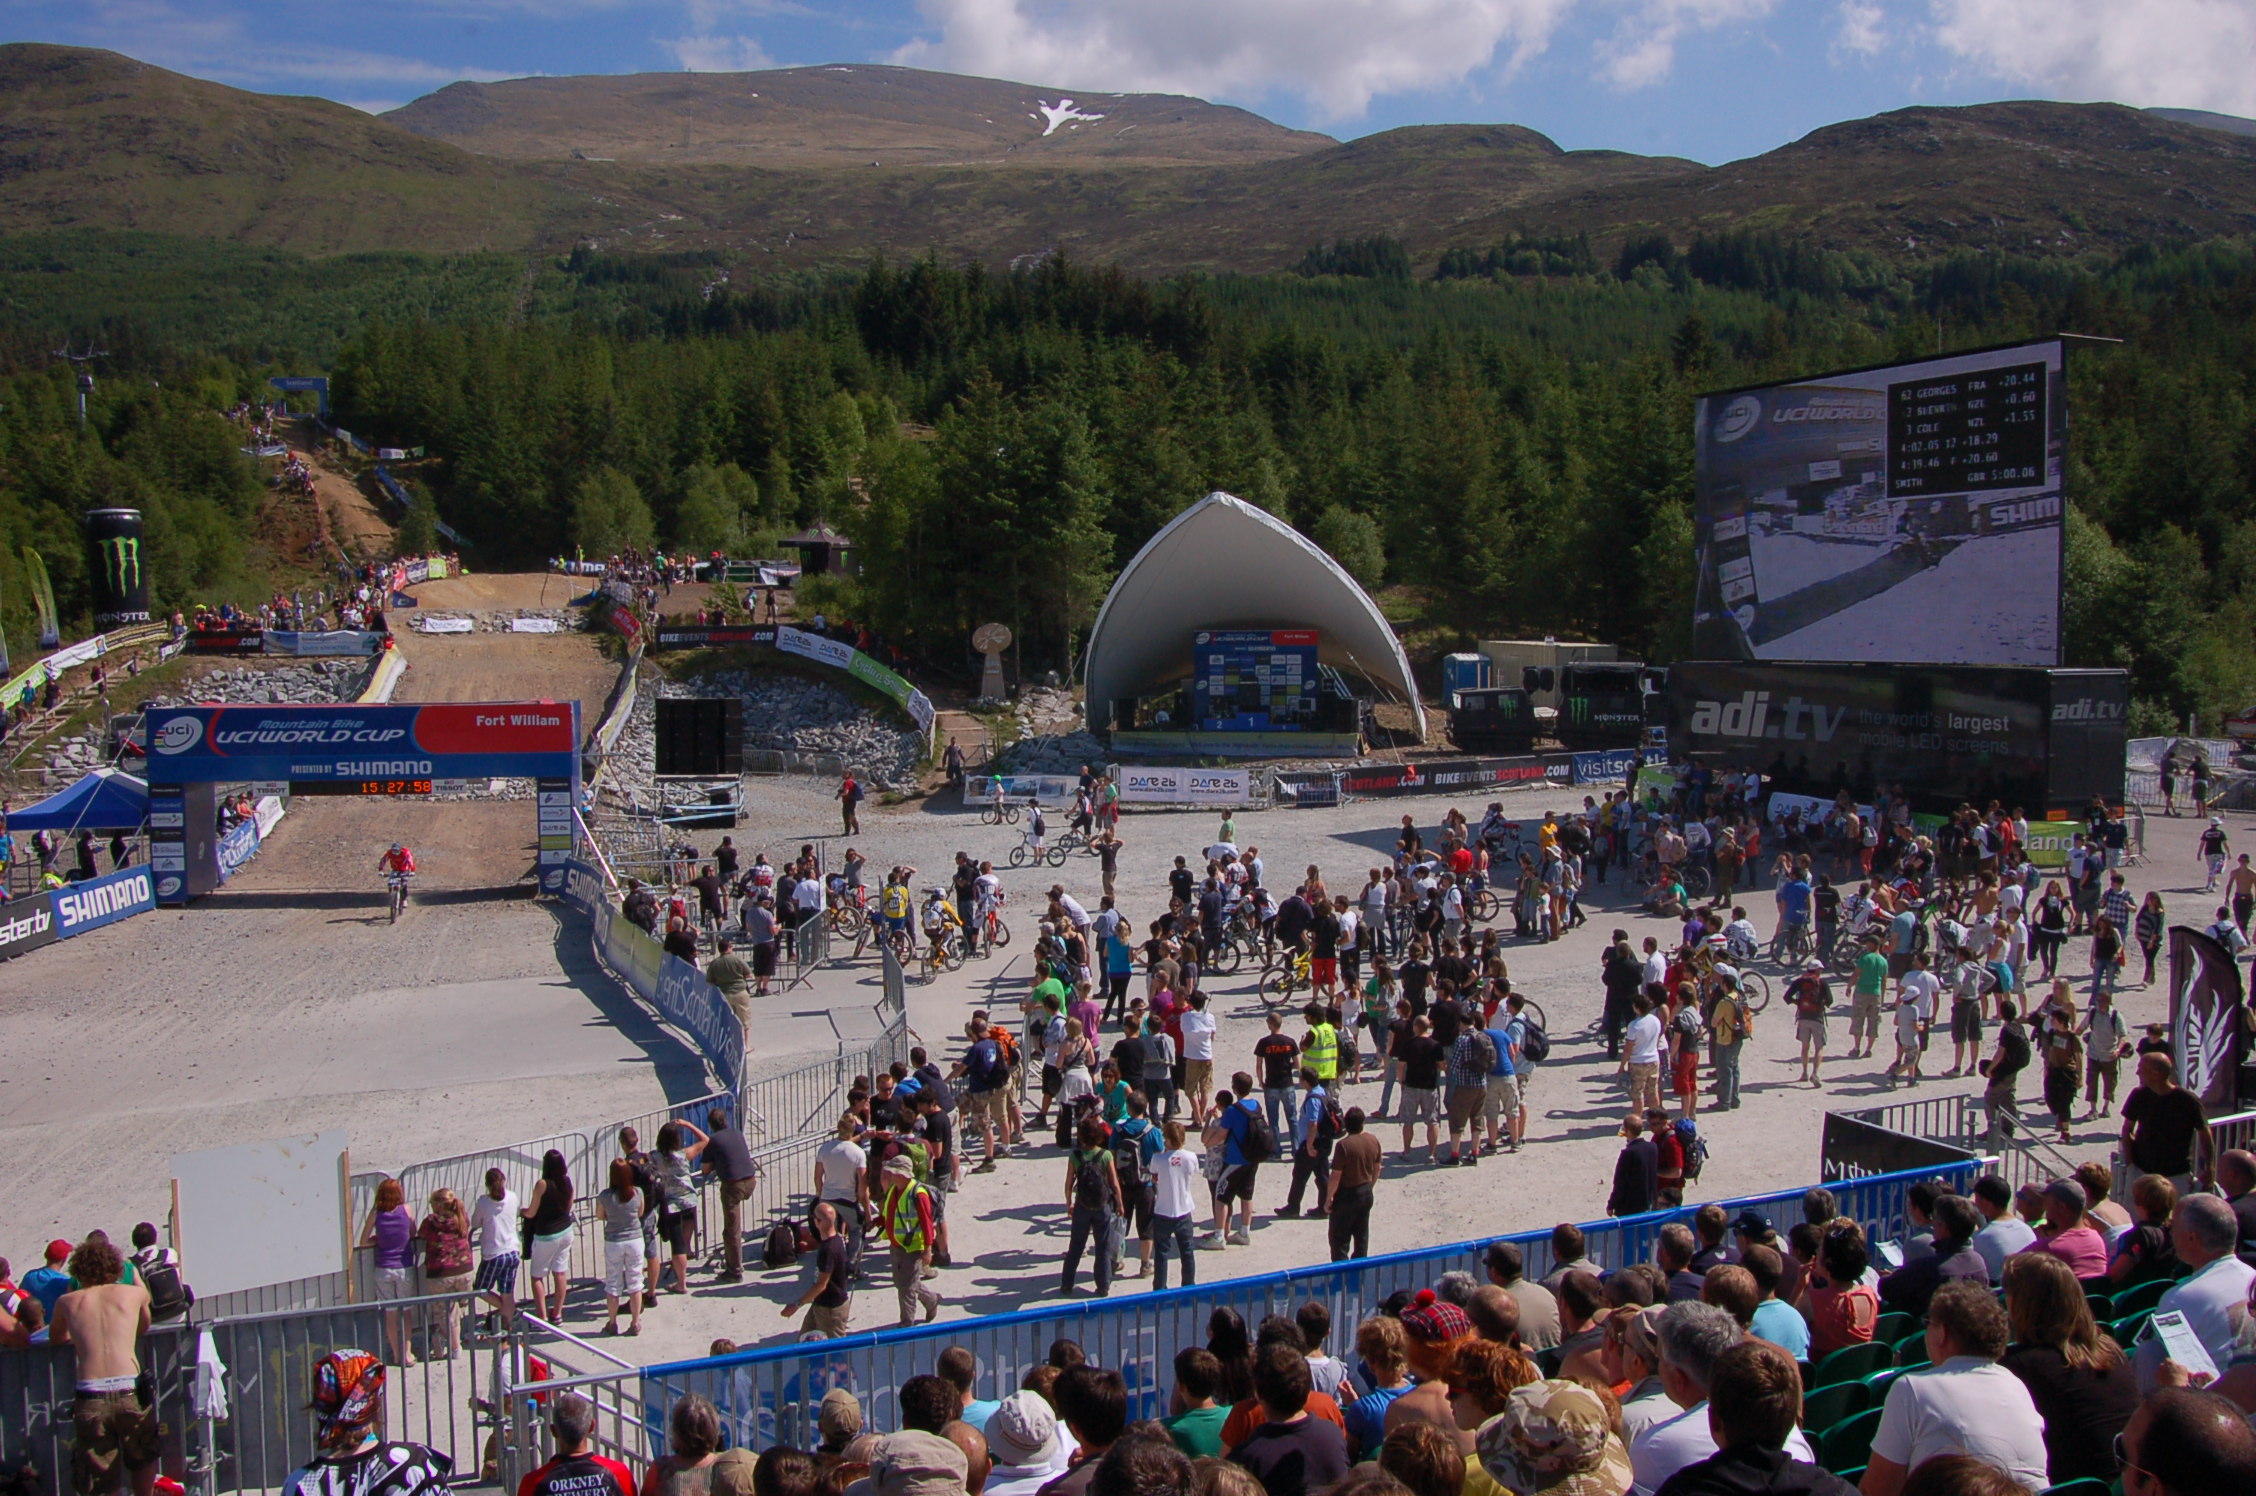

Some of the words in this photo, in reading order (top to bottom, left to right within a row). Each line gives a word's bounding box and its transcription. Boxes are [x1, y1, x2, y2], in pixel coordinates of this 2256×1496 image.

[1917, 385, 1957, 399] GEORGES
[1968, 381, 1986, 392] FRA
[1895, 478, 1923, 489] SMITH
[2052, 697, 2122, 720] adi.tv
[476, 714, 506, 727] Fort
[510, 714, 561, 727] William
[1594, 713, 1640, 722] MONSTER
[1691, 690, 1846, 742] adi.tv
[1859, 708, 1882, 725] the
[1888, 711, 1942, 728] world's
[1948, 712, 2009, 735] largest
[165, 723, 191, 735] UCI
[258, 719, 328, 729] Mountain
[331, 719, 364, 729] Bike
[1216, 720, 1223, 729] 2
[352, 728, 406, 743] CUP
[1859, 732, 1906, 748] mobile
[1910, 733, 1942, 750] LED
[1946, 738, 2009, 755] screens
[336, 760, 433, 776] SHIMANO
[256, 786, 287, 794] TISSOT
[361, 781, 431, 794] 15:27:58
[434, 784, 465, 792] TISSOT
[58, 875, 150, 928] SHIMANO
[549, 1473, 605, 1492] ORKNEY
